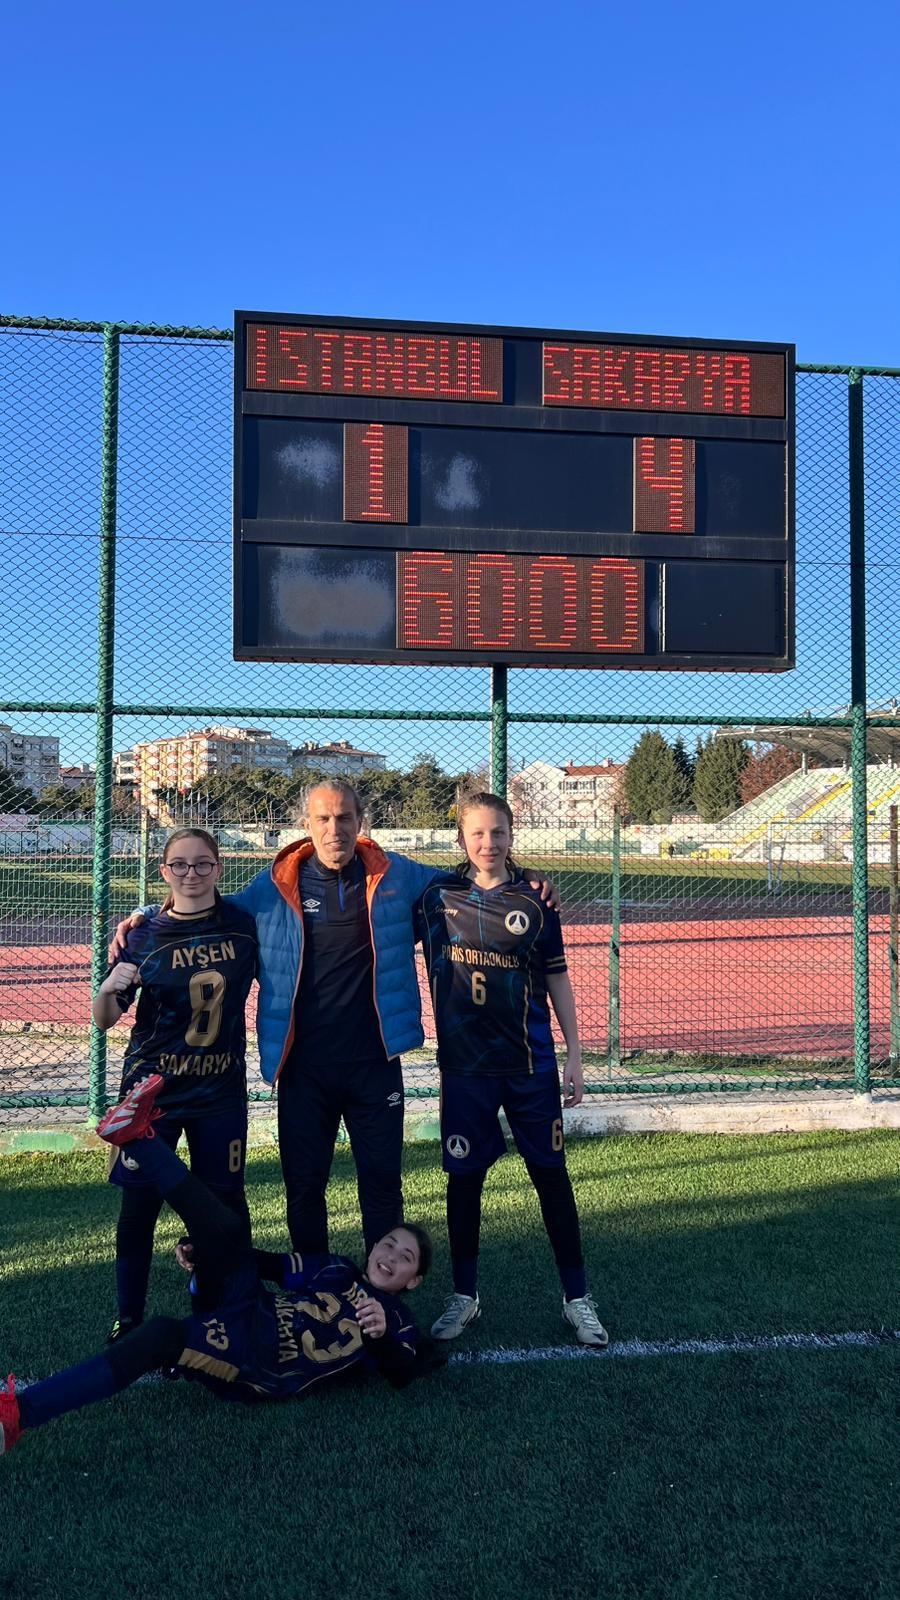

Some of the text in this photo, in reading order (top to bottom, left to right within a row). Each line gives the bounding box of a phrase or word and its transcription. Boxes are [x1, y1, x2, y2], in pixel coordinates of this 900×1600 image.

[256, 328, 498, 395] ISTANBUL
[543, 346, 751, 414] SAKARYA
[361, 423, 391, 517] 1
[641, 436, 683, 529] 4
[171, 940, 236, 970] AYŞEN
[471, 970, 487, 1006] 6
[184, 968, 227, 1047] 8
[228, 1138, 242, 1174] 8
[551, 1117, 563, 1152] 6
[275, 1293, 299, 1364] AKARYA
[294, 1290, 364, 1364] 23
